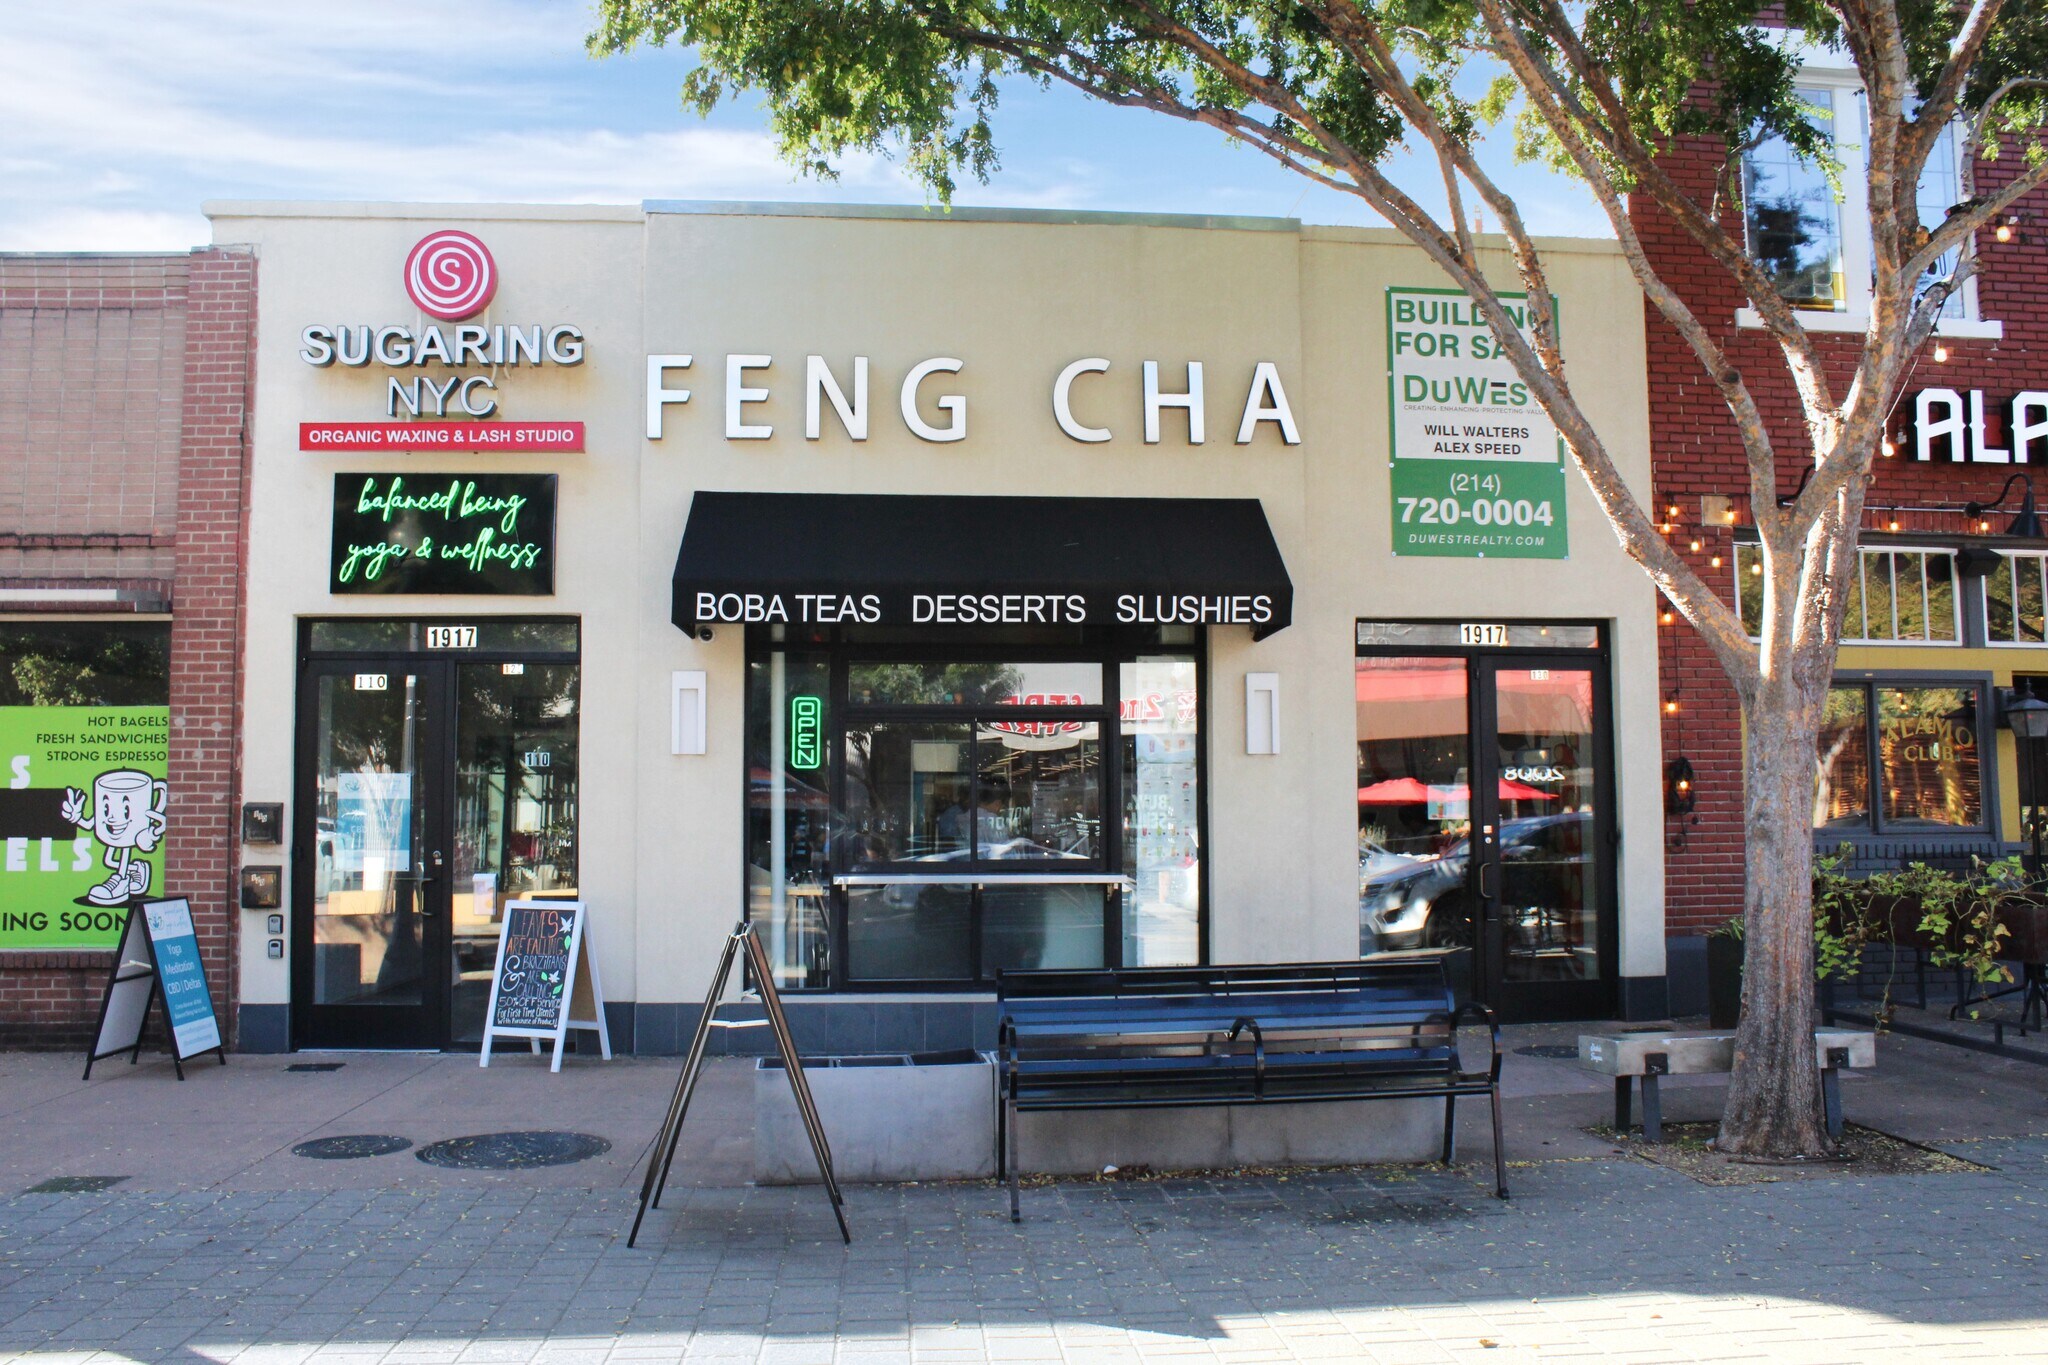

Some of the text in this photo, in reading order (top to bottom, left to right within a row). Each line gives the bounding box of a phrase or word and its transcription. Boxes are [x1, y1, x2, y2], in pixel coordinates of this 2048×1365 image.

[1396, 299, 1536, 329] BUILDN
[299, 324, 585, 368] SUGARING
[1396, 332, 1459, 358] FOR
[387, 375, 499, 419] NYC
[646, 354, 1301, 447] FENG CHA
[1404, 374, 1531, 405] DuWES
[1403, 404, 1437, 412] CREATING
[1440, 405, 1479, 413] ENHANCING
[1482, 407, 1524, 415] PROTECTING
[309, 428, 574, 443] ORGANIC WAXING & LASH STUDIO
[1424, 425, 1529, 438] WILL WALTERS
[1434, 442, 1521, 455] ALEX SPEED
[1450, 473, 1501, 496] (214)
[357, 476, 527, 533] balanced being
[1397, 497, 1553, 527] 720-0004
[1408, 533, 1545, 546] DUWESTREALTY.COM
[339, 527, 541, 583] yoga & wellness
[696, 593, 881, 622] BOBA TEAS
[912, 595, 1086, 623] DESSERTS
[1115, 595, 1272, 623] SLUSHIES
[430, 627, 476, 648] 1917
[1464, 625, 1505, 644] 1917
[357, 676, 386, 689] 110
[88, 716, 168, 727] HOT BAGELS
[1885, 714, 1974, 748] ALAMO
[36, 733, 167, 744] FRESH SANDWICHES
[796, 701, 816, 766] OPEN
[47, 751, 167, 761] STRONG ESPRESSO
[526, 752, 549, 767] 110
[1904, 745, 1954, 761] CLUB
[10, 755, 31, 789] S
[6, 837, 92, 872] ELS
[2, 912, 49, 931] ING
[512, 910, 559, 938] LEAVES
[166, 944, 182, 956] Yoga
[505, 937, 564, 956] ARE FALLING
[164, 960, 195, 976] Meditation
[167, 982, 181, 995] CBD
[184, 978, 202, 992] Deltas
